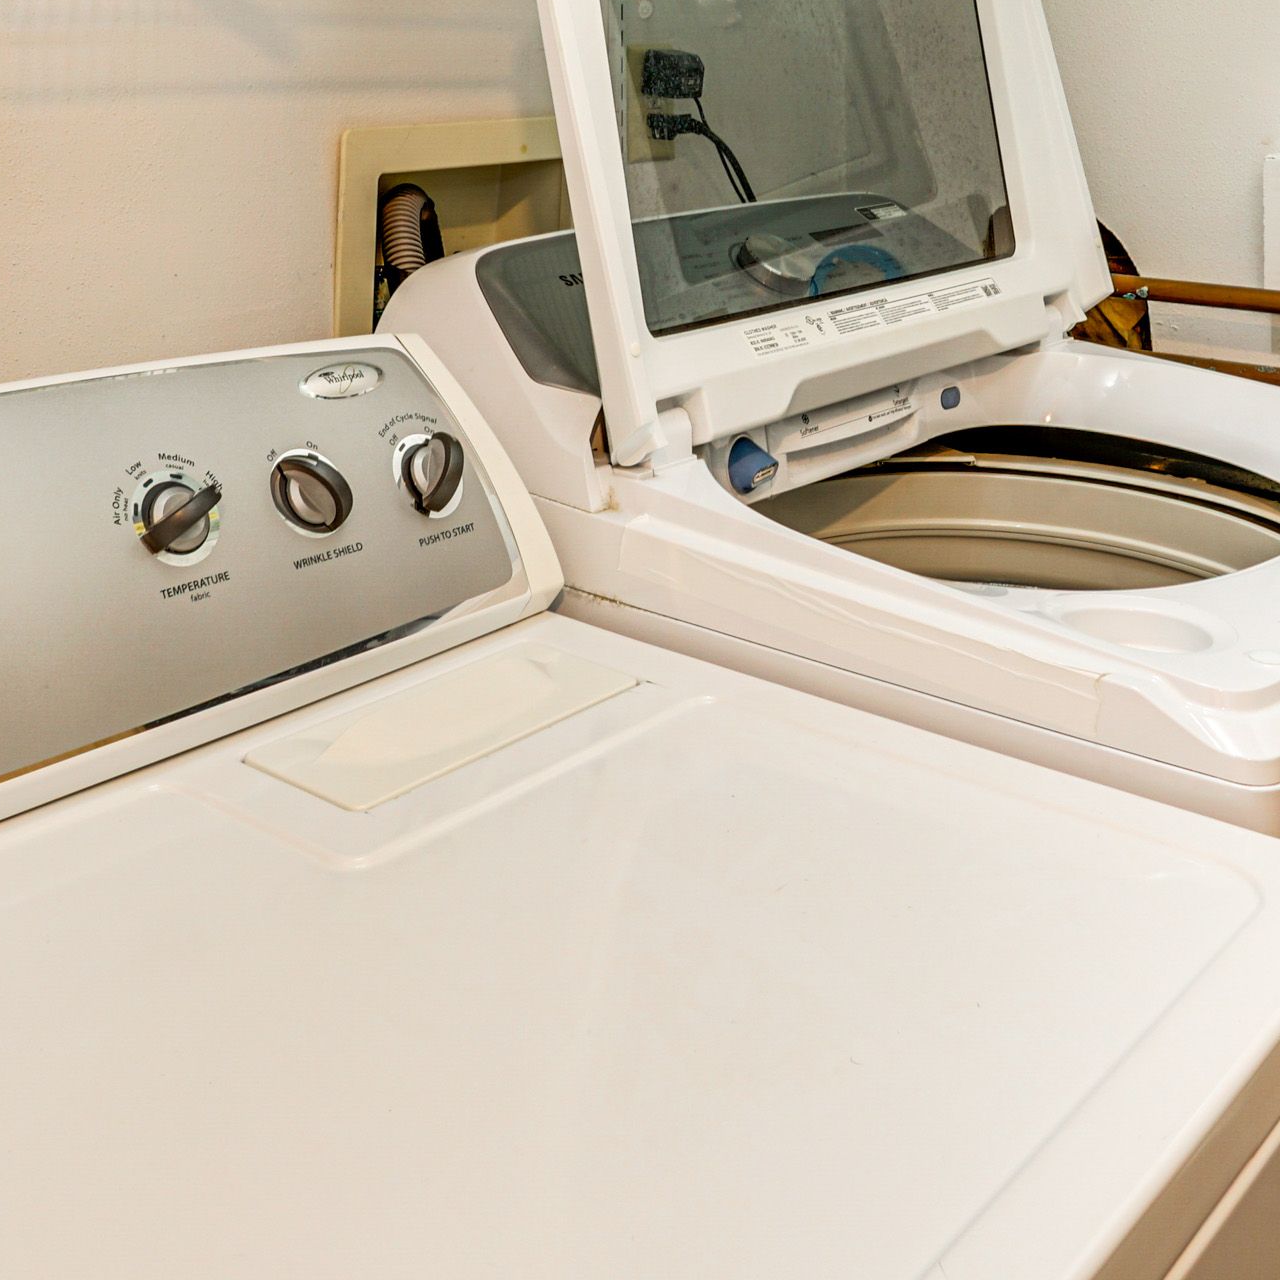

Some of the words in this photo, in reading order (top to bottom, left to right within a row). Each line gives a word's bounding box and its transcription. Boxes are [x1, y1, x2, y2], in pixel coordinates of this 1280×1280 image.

[325, 369, 365, 386] Whirlpool
[378, 424, 390, 438] End
[395, 412, 413, 423] Cycle
[414, 412, 438, 424] Signal
[306, 440, 318, 450] On
[389, 433, 399, 446] Off
[158, 453, 195, 467] Medium
[267, 448, 278, 462] Off
[125, 461, 142, 476] Low
[205, 470, 223, 491] High
[112, 487, 124, 511] Only
[113, 511, 122, 525] Air
[418, 534, 440, 547] PUSH
[440, 530, 452, 540] TO
[452, 522, 475, 537] START
[293, 552, 333, 571] WRINKLE
[333, 542, 364, 559] SHIELD
[160, 571, 231, 600] TEMPERATURE
[190, 590, 211, 603] fabric
